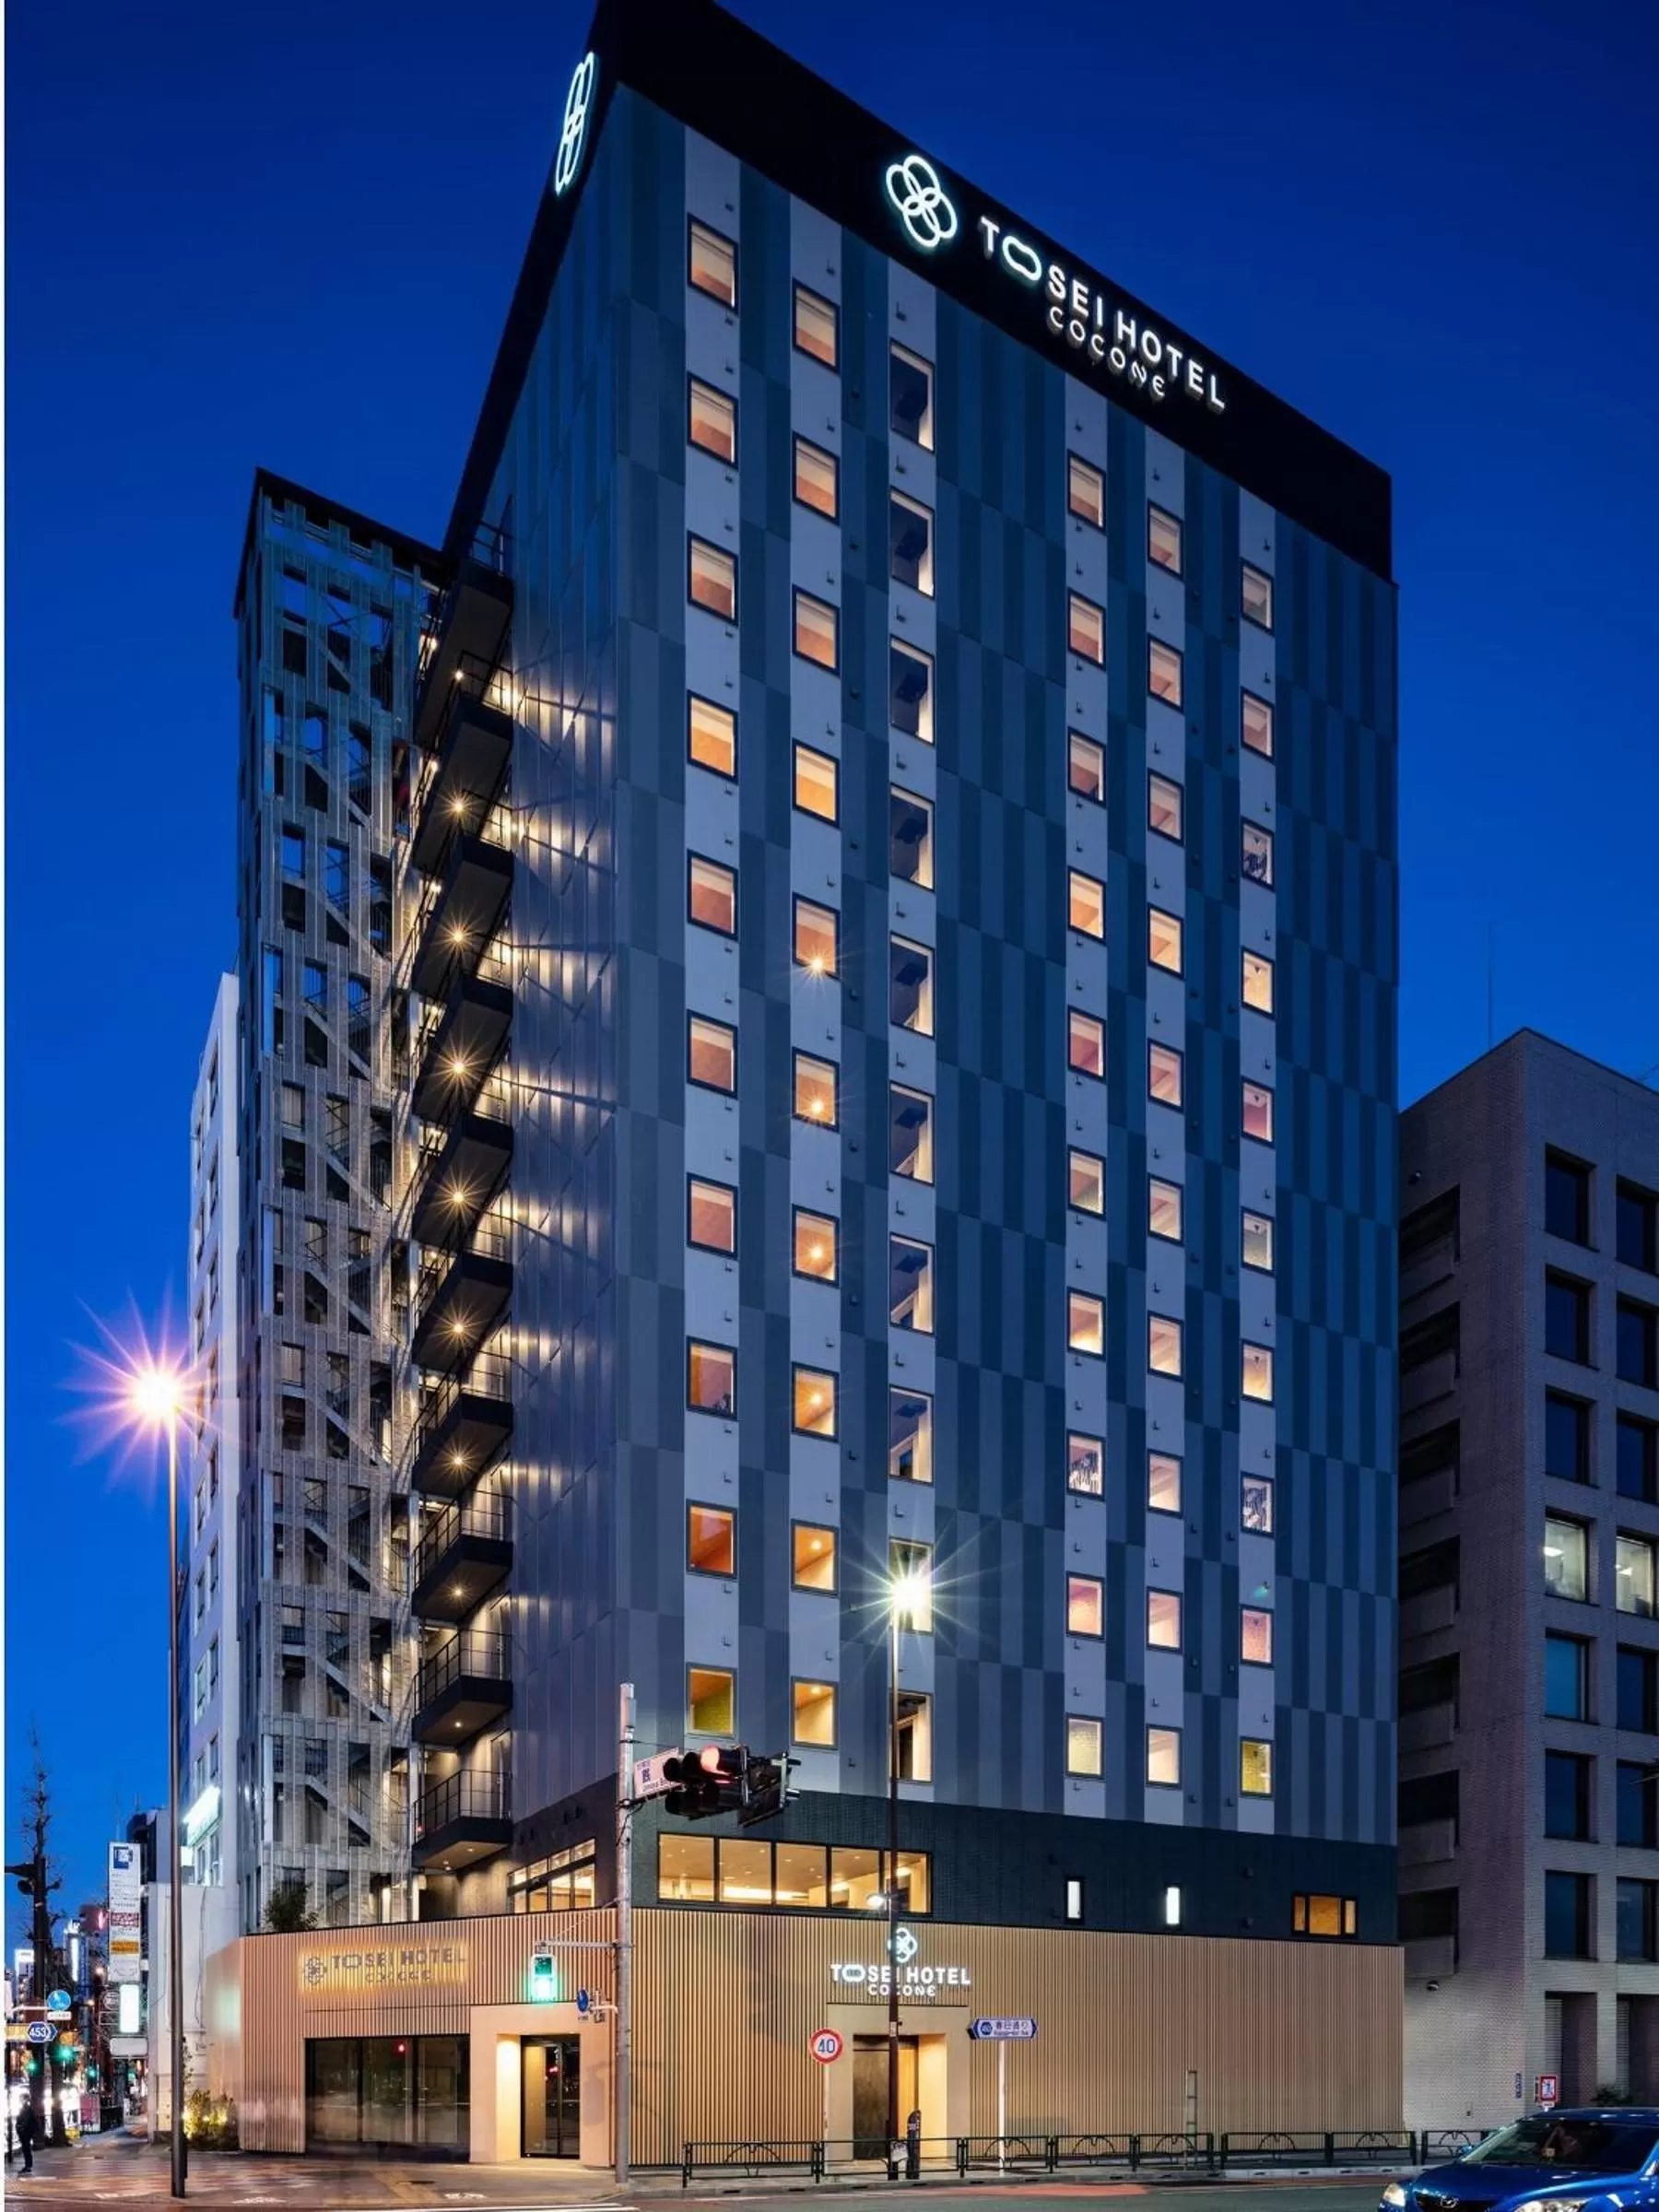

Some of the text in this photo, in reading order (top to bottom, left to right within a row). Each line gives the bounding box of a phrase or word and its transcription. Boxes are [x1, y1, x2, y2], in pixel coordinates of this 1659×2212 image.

[979, 215, 1226, 411] TOSEI HOTEL
[1048, 306, 1166, 399] COCONE
[401, 1947, 466, 1965] HOTEL
[906, 1967, 971, 1984] HOTEL
[868, 1984, 936, 1996] COONE
[29, 2027, 47, 2038] 453
[818, 2039, 835, 2053] 40
